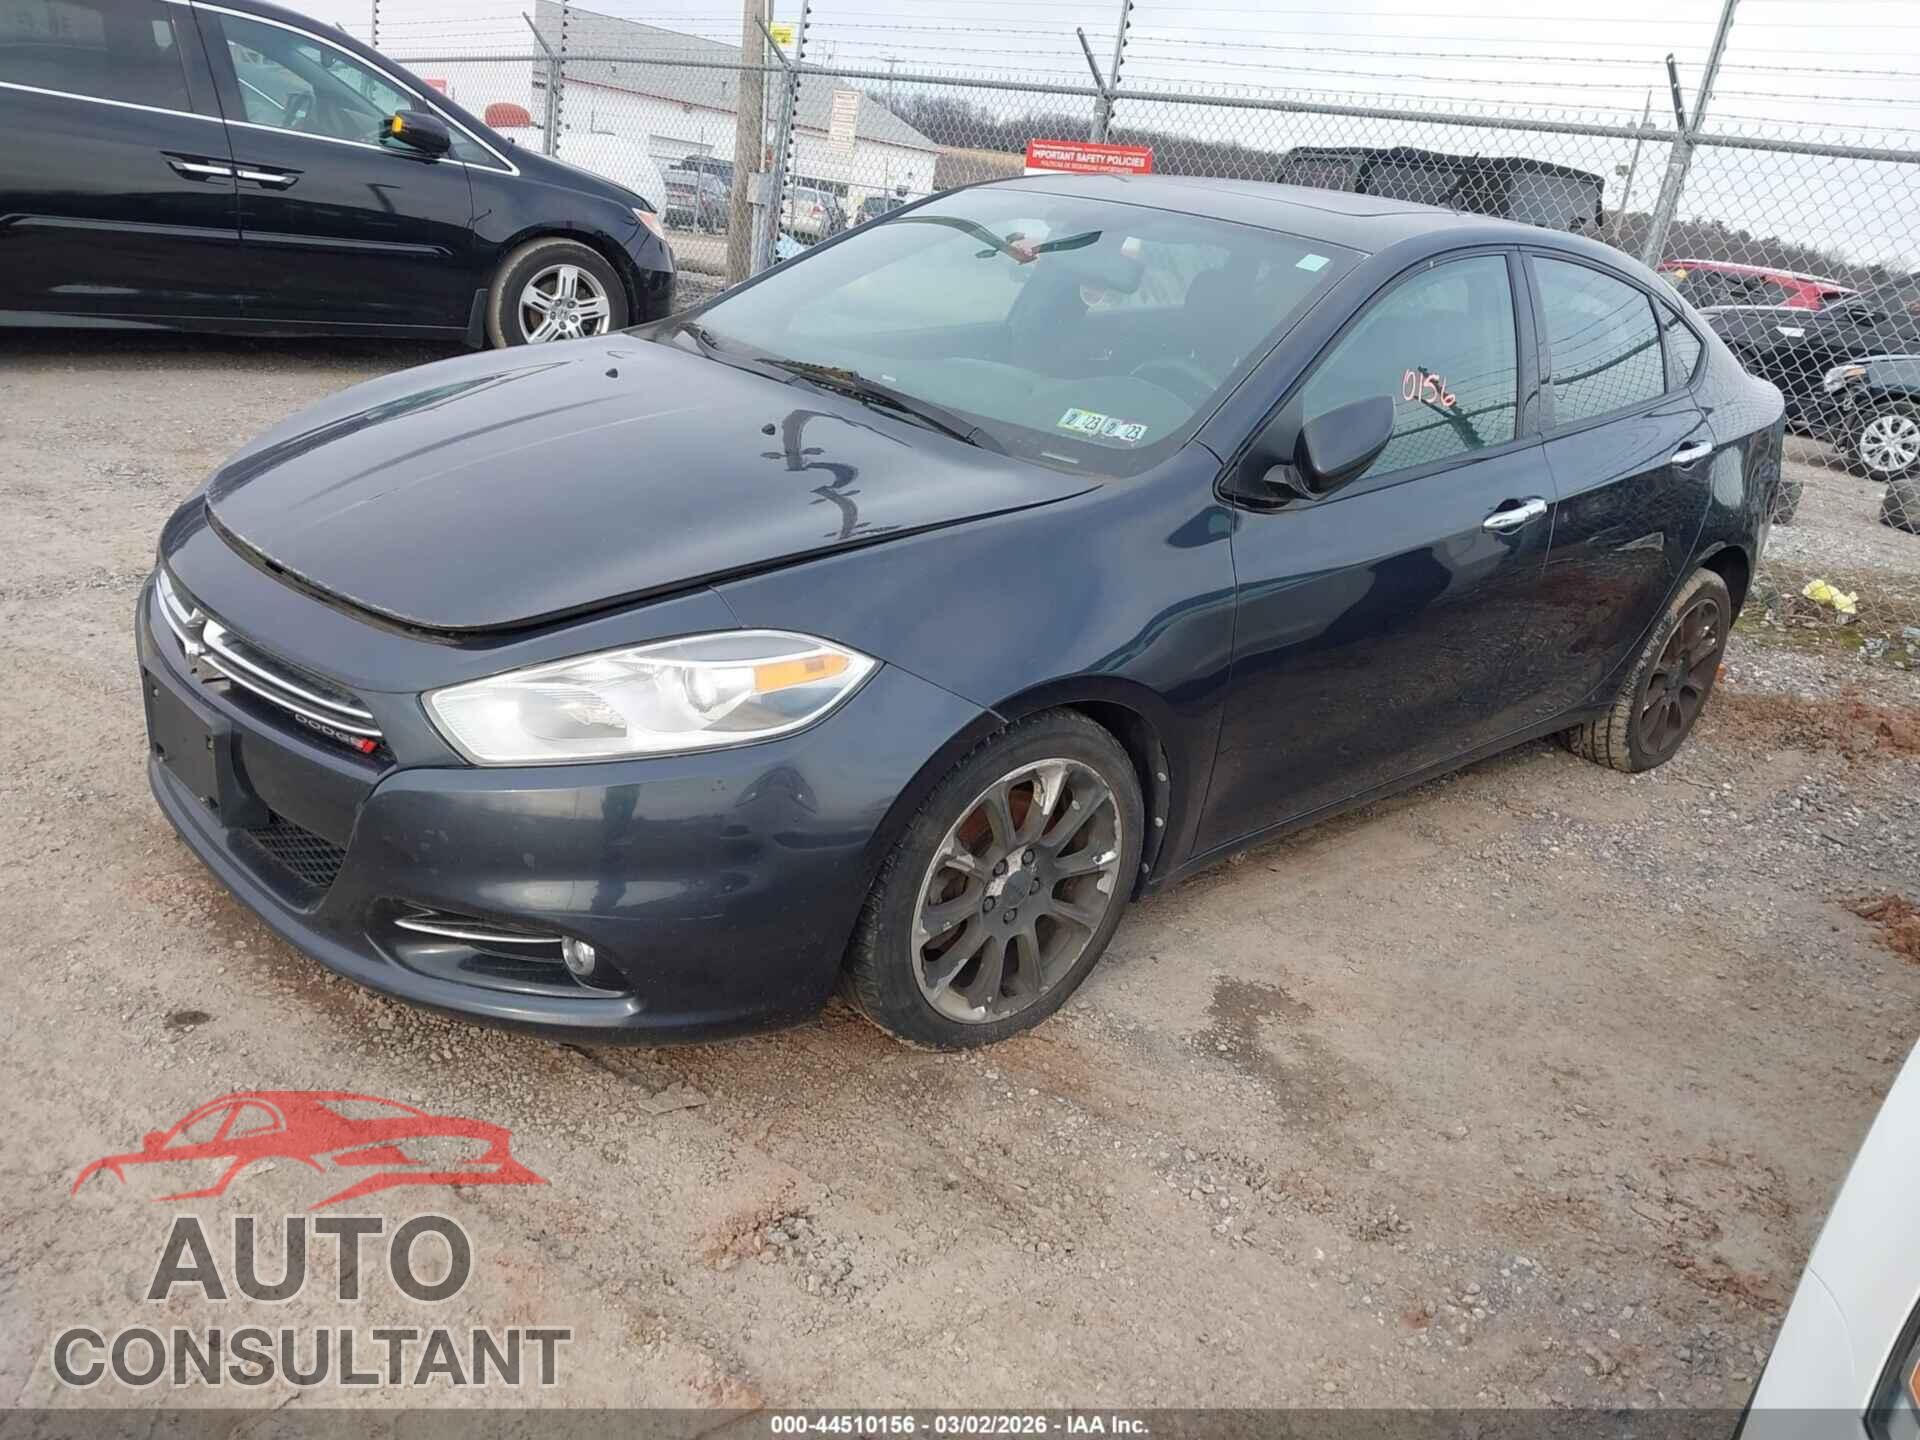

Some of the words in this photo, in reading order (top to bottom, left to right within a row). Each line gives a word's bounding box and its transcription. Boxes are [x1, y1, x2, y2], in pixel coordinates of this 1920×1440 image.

[1032, 150, 1075, 161] IMPORTANT
[1076, 152, 1105, 164] SAFETY
[1106, 155, 1146, 168] POLICIES
[1402, 368, 1456, 407] 0156
